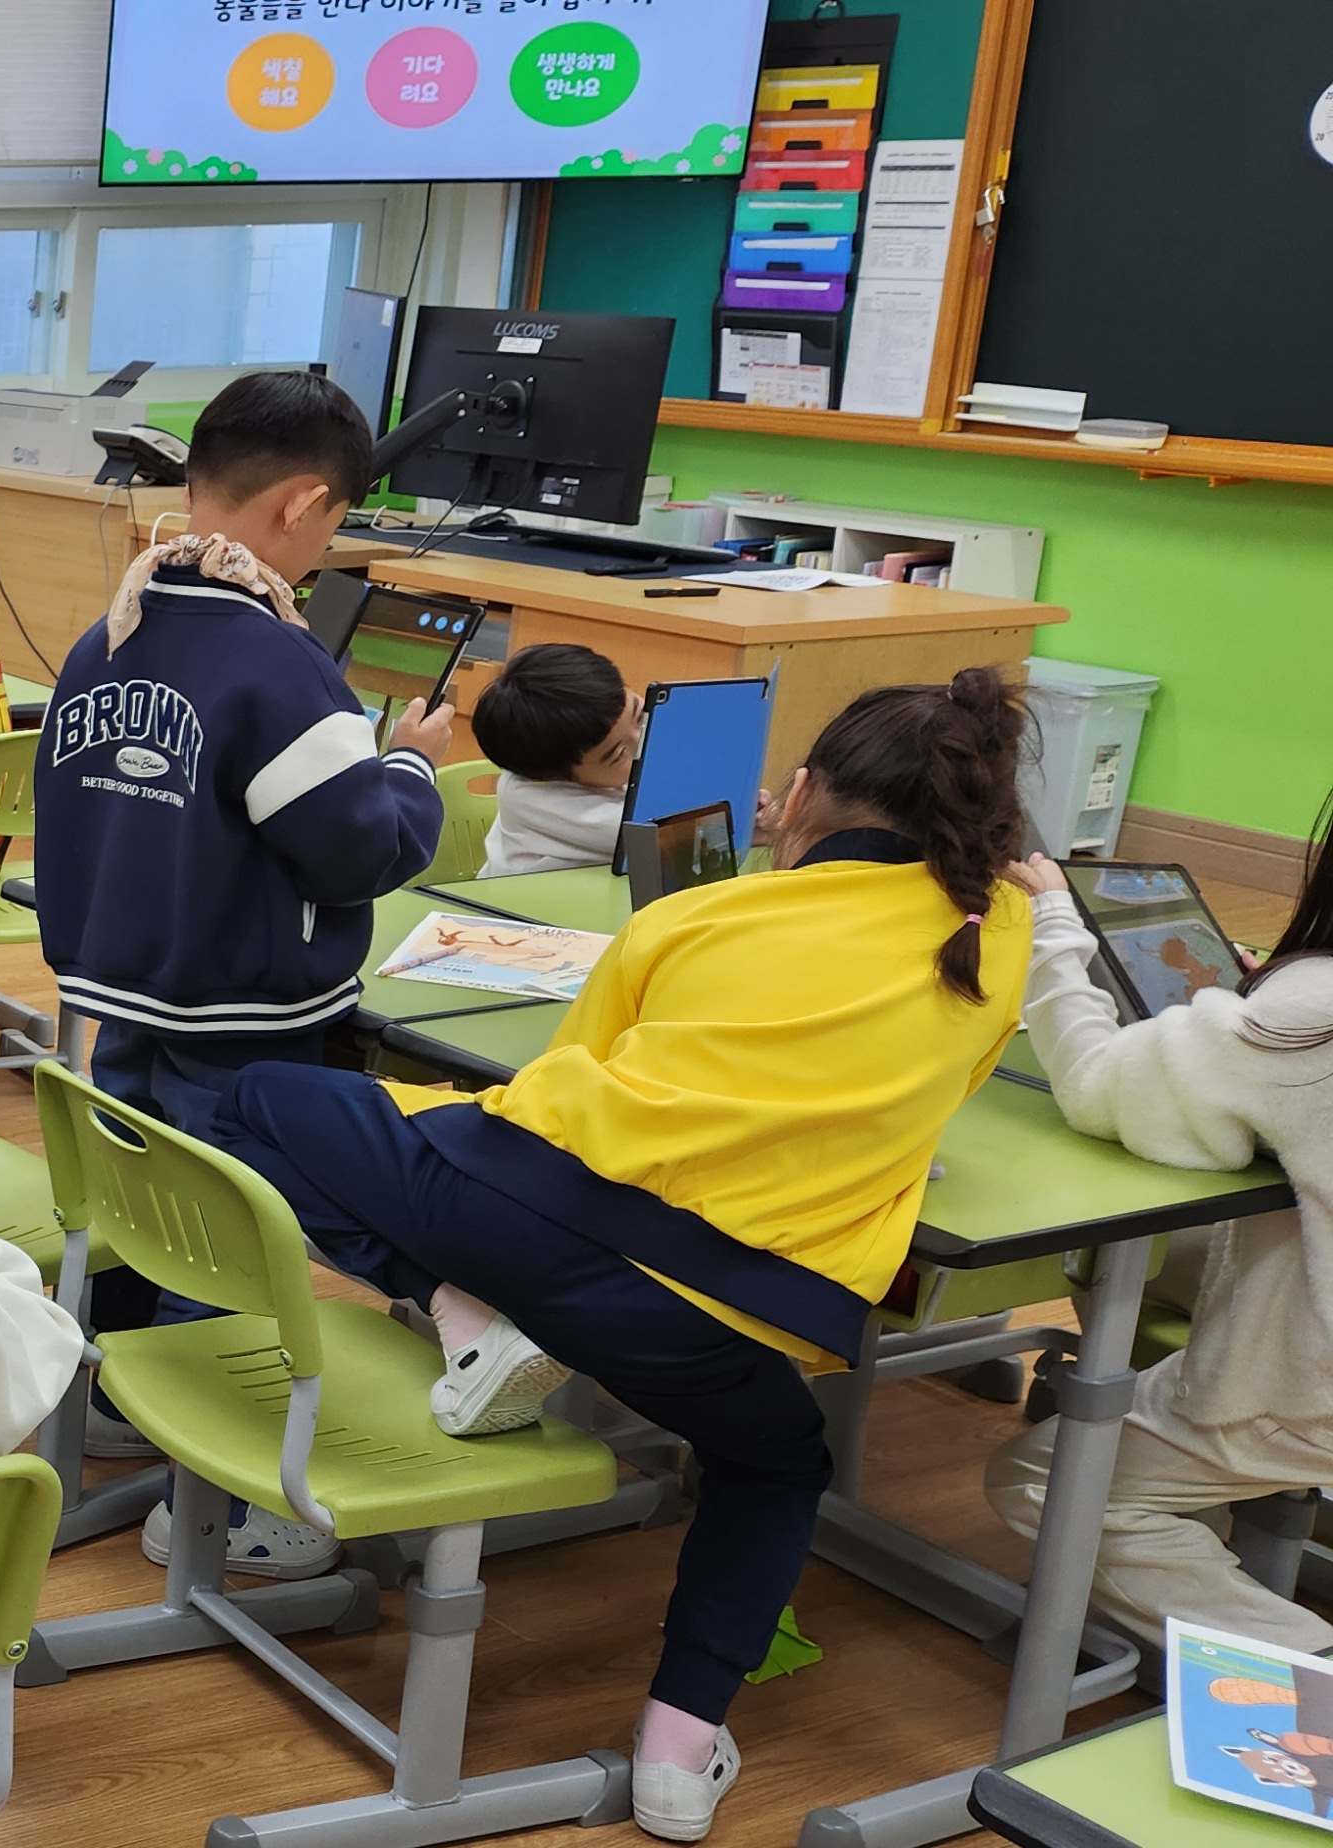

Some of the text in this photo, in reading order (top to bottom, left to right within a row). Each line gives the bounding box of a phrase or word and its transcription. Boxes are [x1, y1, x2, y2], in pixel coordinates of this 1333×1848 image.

[261, 57, 303, 82] 색칠
[402, 55, 445, 74] 기다
[536, 52, 616, 76] 생생하게
[258, 85, 299, 107] 해요
[399, 81, 440, 103] 려요
[544, 77, 601, 101] 만나요
[493, 321, 561, 340] LUCOMS
[53, 679, 204, 795] BROWN
[81, 776, 185, 808] BETTER GOOD TOGETHER
